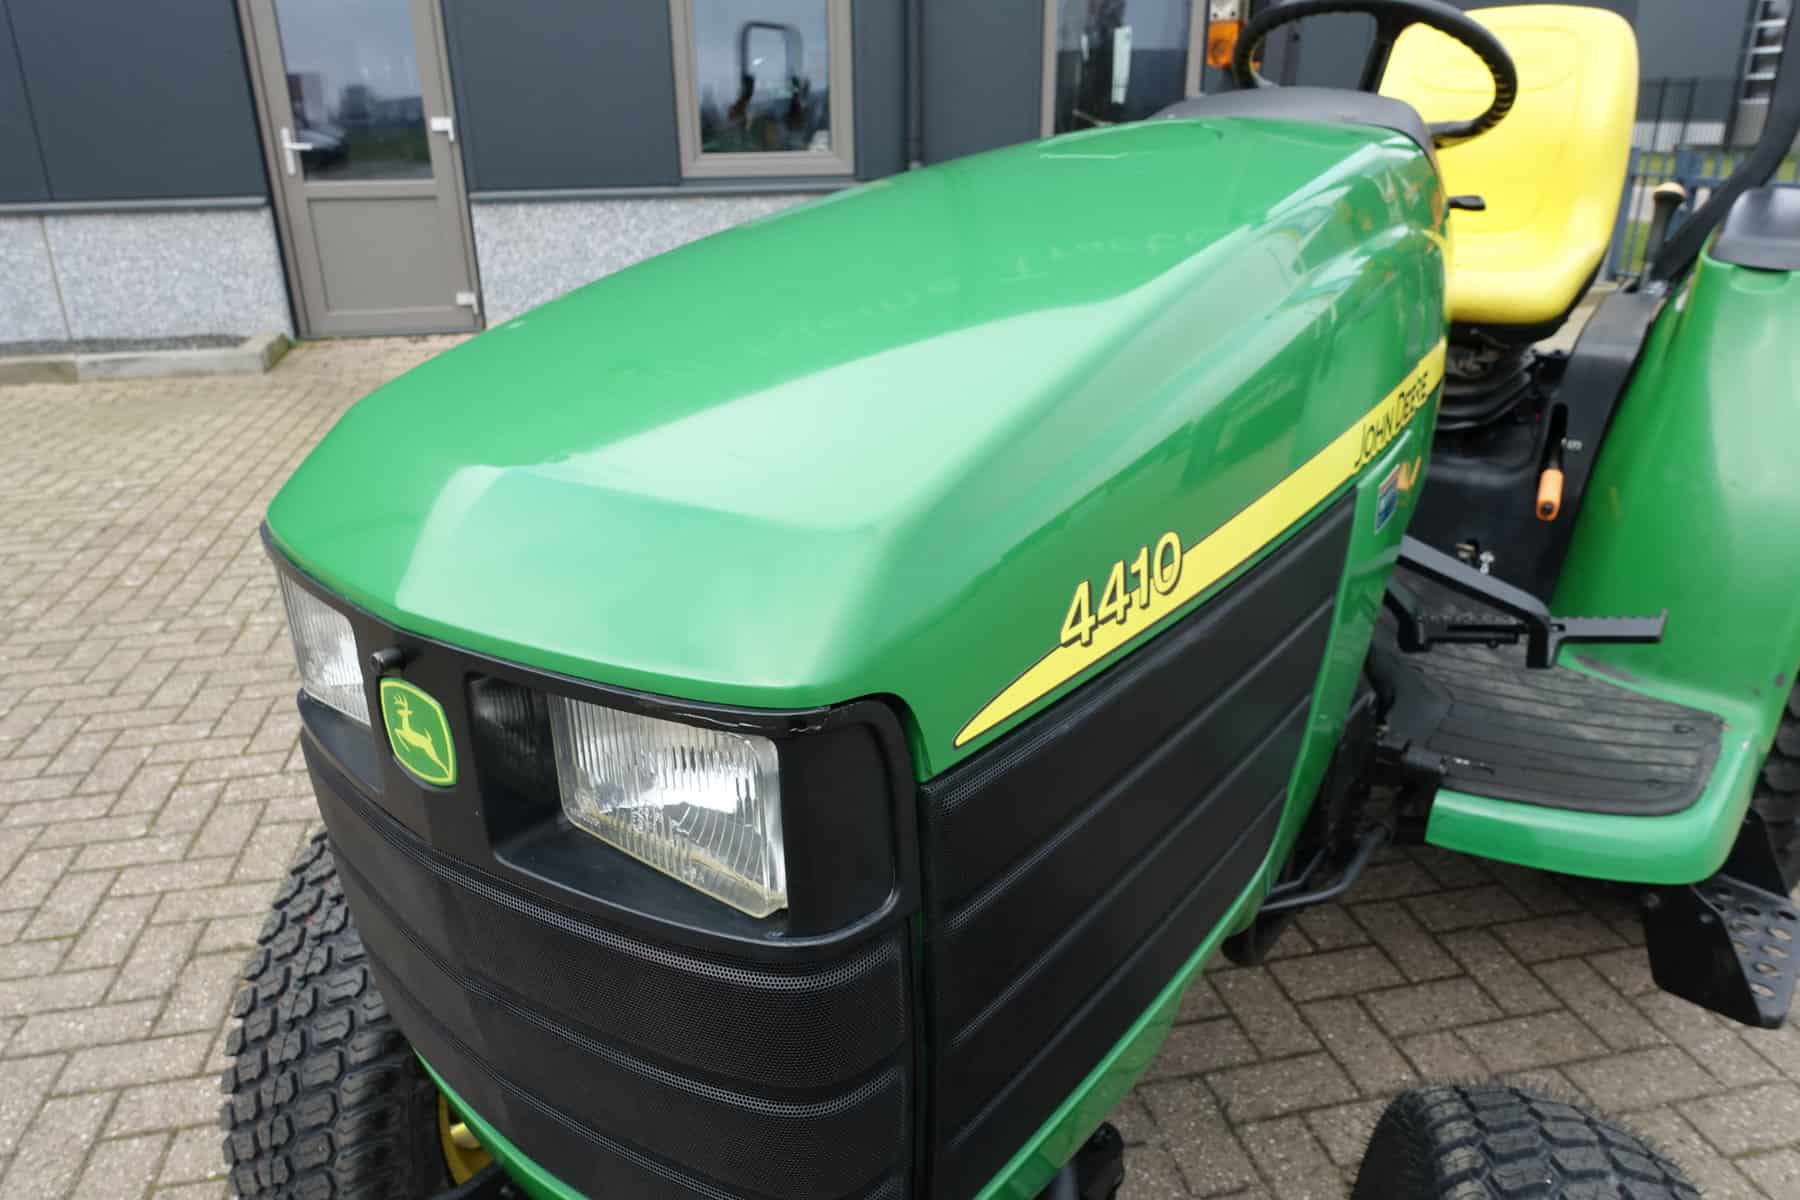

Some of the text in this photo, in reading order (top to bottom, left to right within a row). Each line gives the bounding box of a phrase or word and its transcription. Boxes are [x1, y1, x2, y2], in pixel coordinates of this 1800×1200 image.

[1354, 371, 1428, 467] JOHN DEERE
[1060, 530, 1183, 648] 4410
